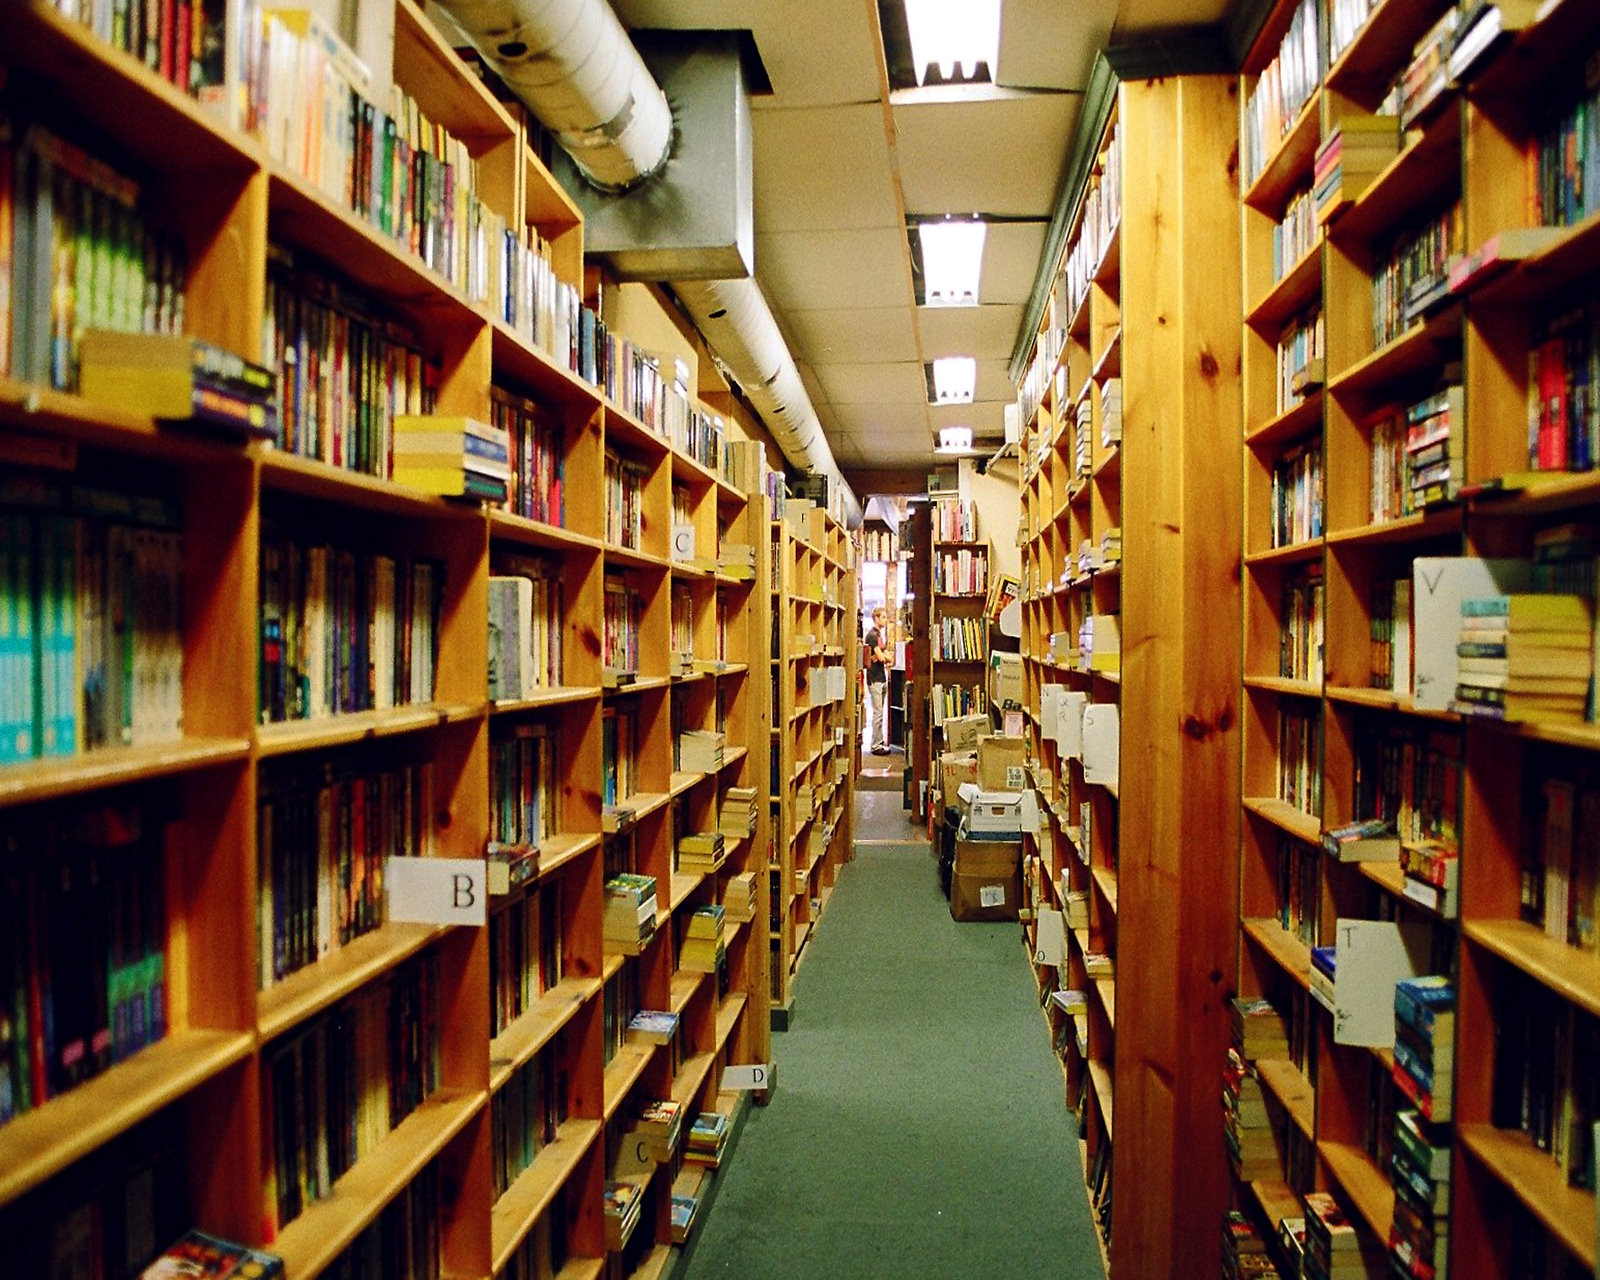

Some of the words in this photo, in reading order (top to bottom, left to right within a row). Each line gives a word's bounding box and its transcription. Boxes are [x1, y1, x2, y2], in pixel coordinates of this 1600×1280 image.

[675, 533, 690, 553] C
[1421, 567, 1444, 595] V
[452, 874, 475, 908] B
[1342, 927, 1358, 948] T
[752, 1068, 764, 1083] D
[636, 1141, 648, 1163] C
